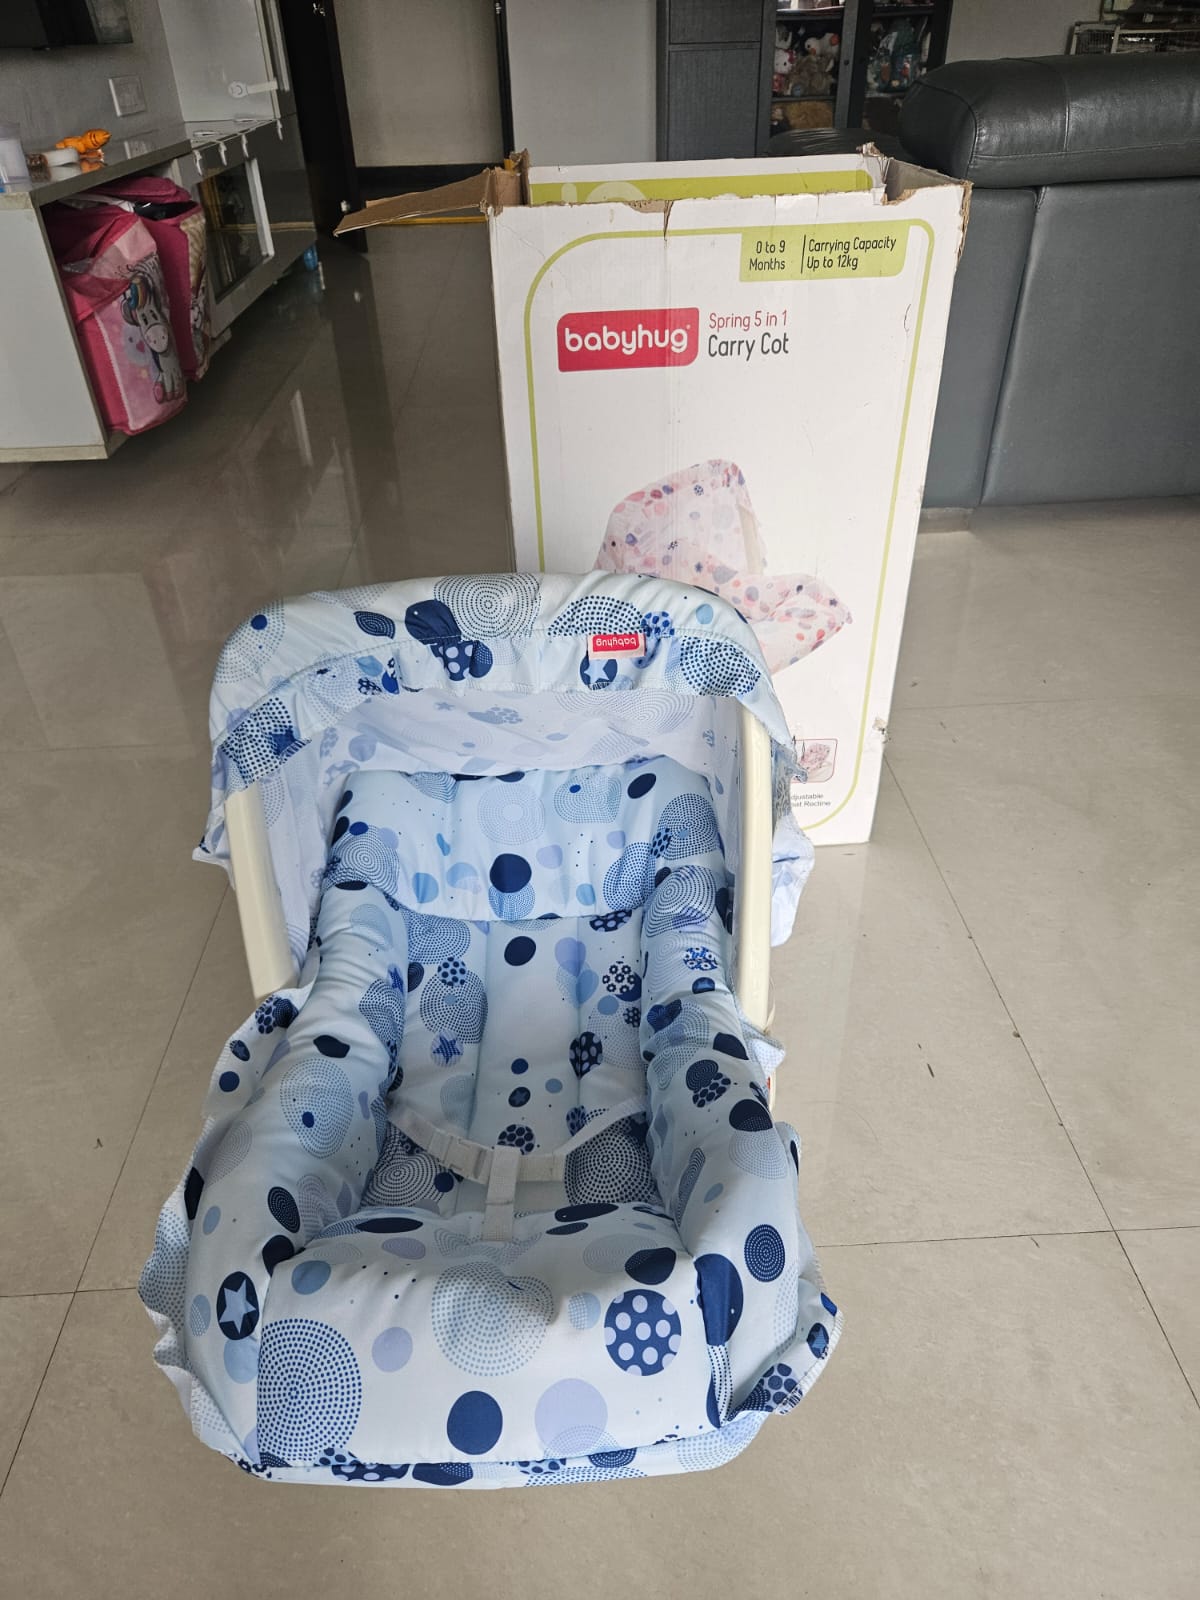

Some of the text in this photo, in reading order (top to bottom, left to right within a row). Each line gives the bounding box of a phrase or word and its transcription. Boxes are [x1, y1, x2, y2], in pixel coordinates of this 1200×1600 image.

[765, 241, 776, 254] to
[779, 240, 786, 253] 9
[808, 236, 897, 254] Carrying Capacity
[750, 258, 786, 271] Months
[806, 254, 859, 271] Up to 12kg
[709, 309, 788, 332] Spring 5 in 1
[564, 324, 688, 355] babyhug
[708, 331, 789, 361] Carry Cot
[595, 637, 637, 647] babyhug
